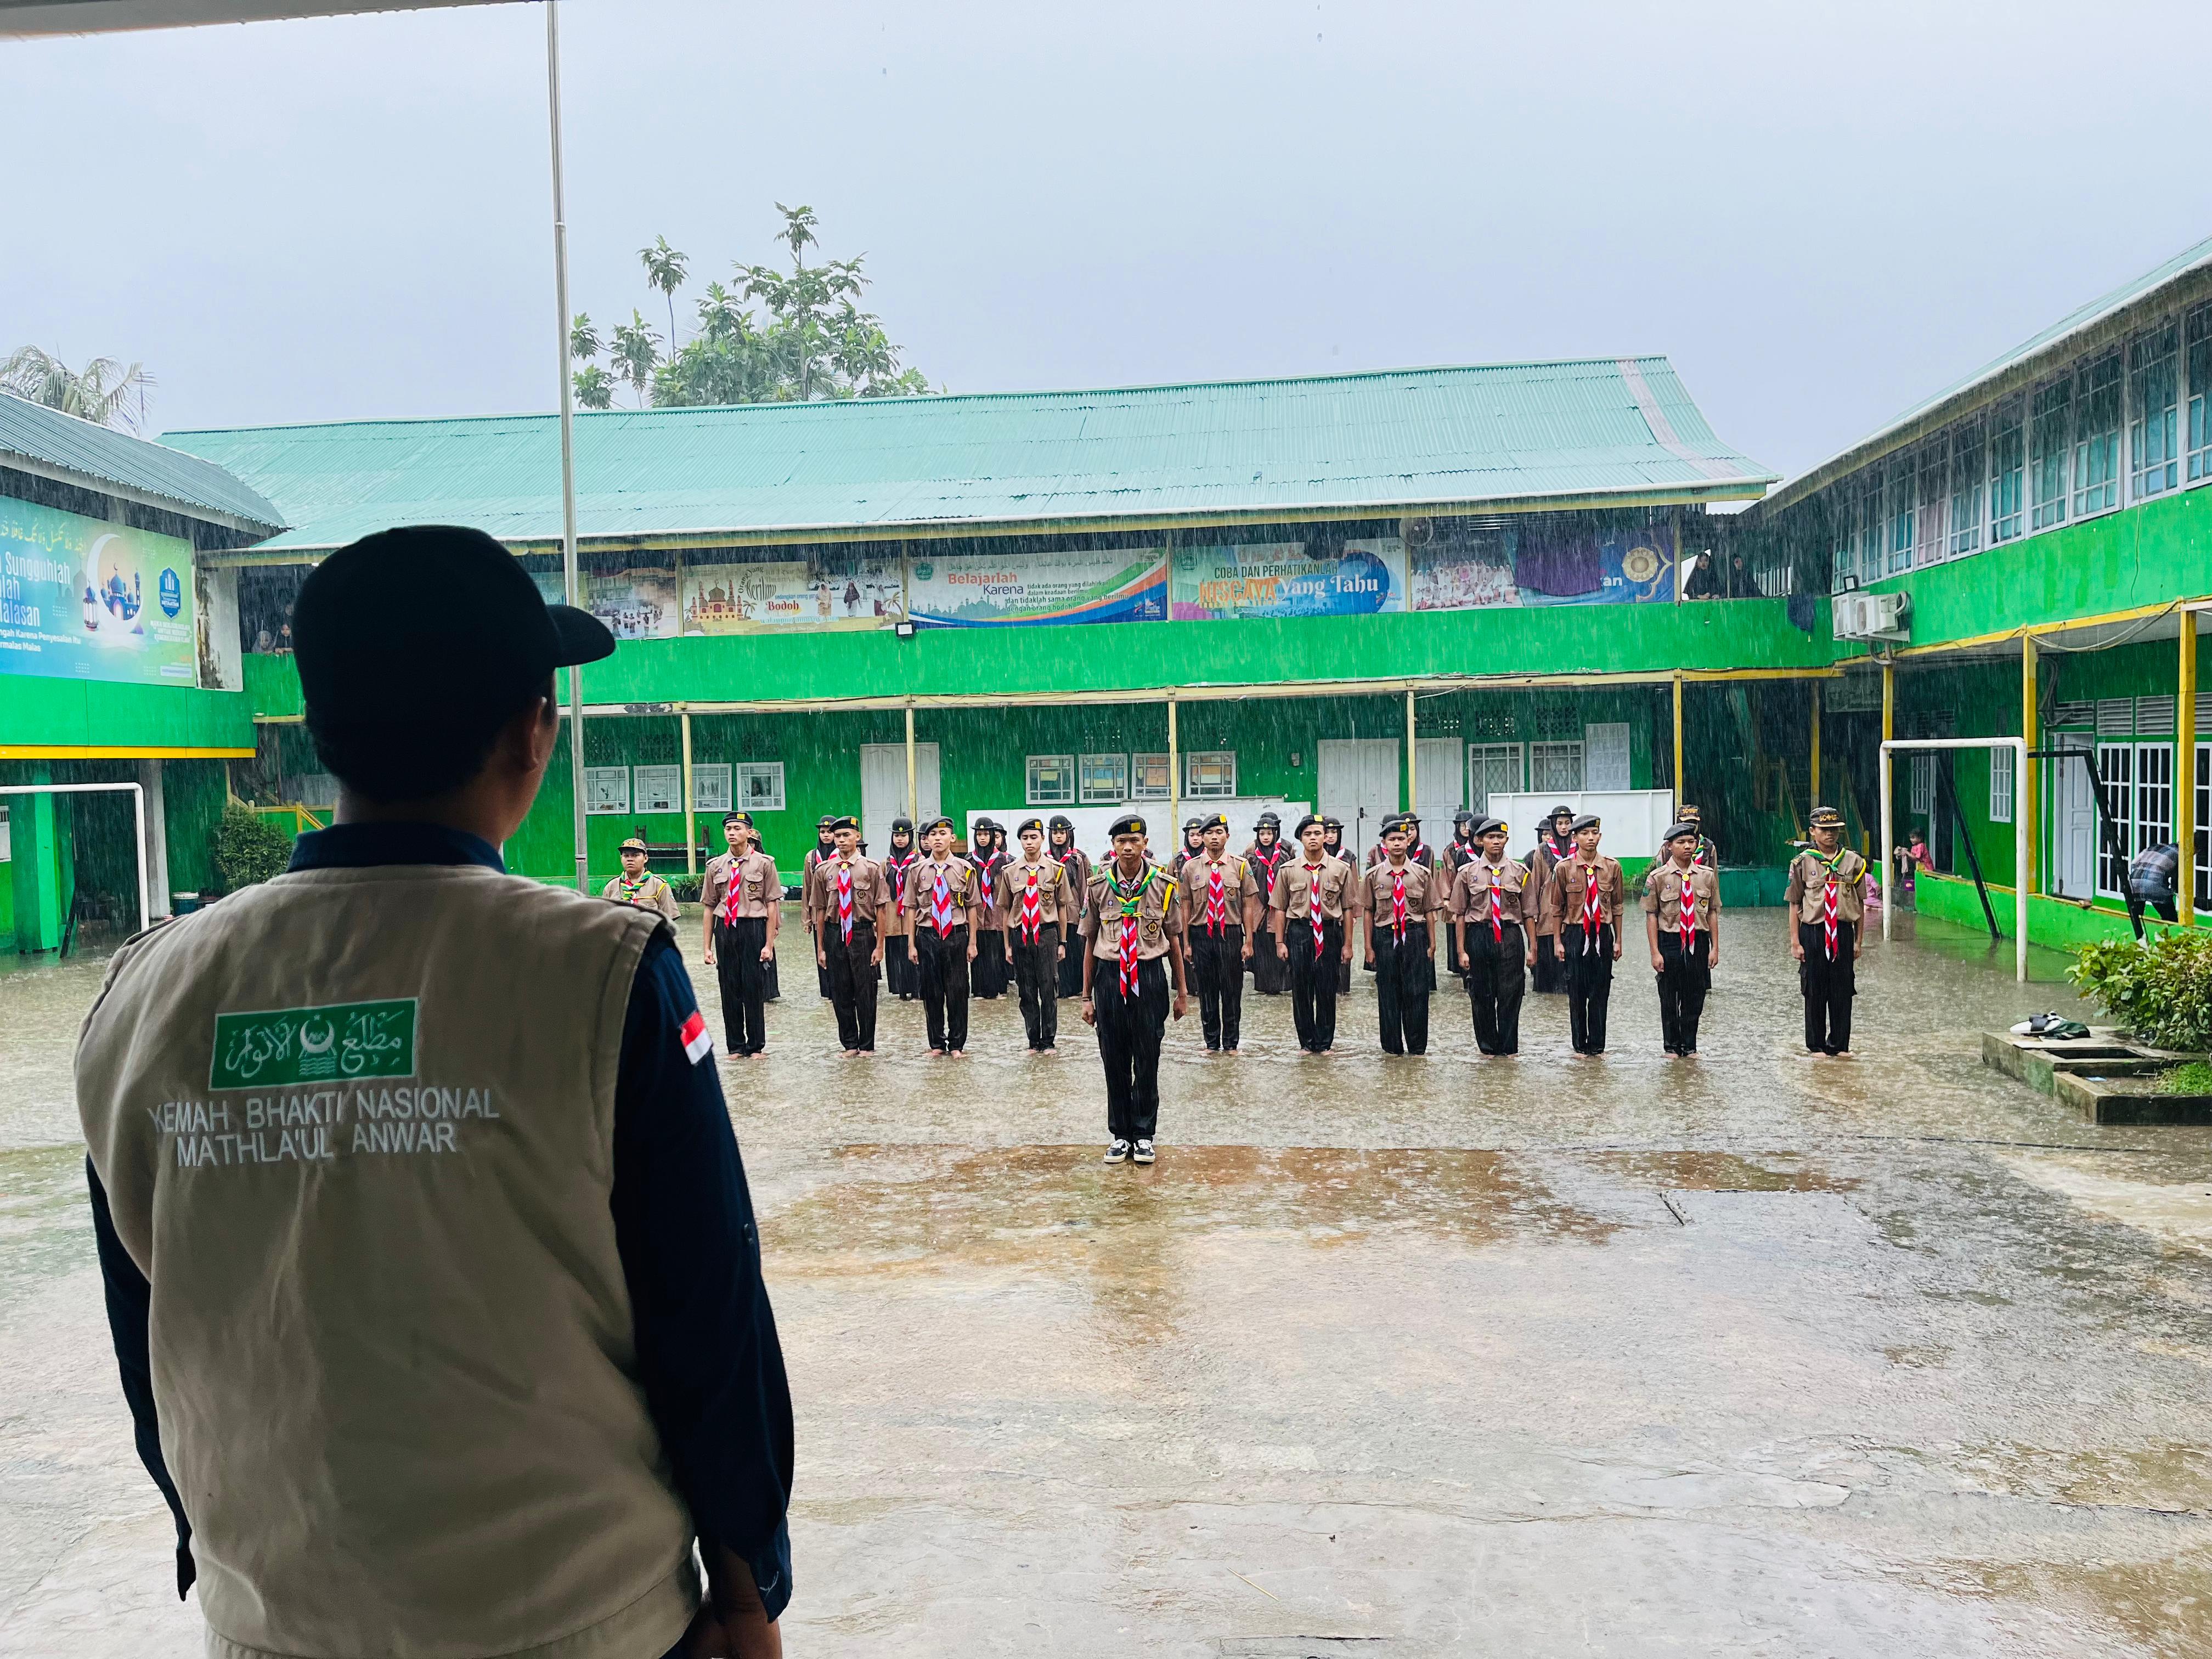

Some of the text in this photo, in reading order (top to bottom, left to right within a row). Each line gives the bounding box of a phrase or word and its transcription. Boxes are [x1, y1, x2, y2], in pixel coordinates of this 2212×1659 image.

[5, 551, 71, 585] Sungguhlah
[1215, 561, 1338, 578] COBA DAN PERHATIKANLAH
[948, 571, 1017, 586] Belajarlah
[983, 584, 1024, 595] Karena
[1199, 574, 1379, 604] NISCAYA Yang Tahu
[765, 600, 799, 611] Bodoh
[1020, 596, 1046, 604] tidaklah
[1104, 592, 1128, 600] berilmu
[15, 629, 38, 640] Karena
[38, 631, 72, 644] Penyesalan
[22, 642, 42, 652] Malas
[247, 1090, 345, 1130] BHAKTI
[356, 1087, 501, 1120] NASIONAL
[177, 1122, 458, 1167] MATHLA'UL ANWAR
